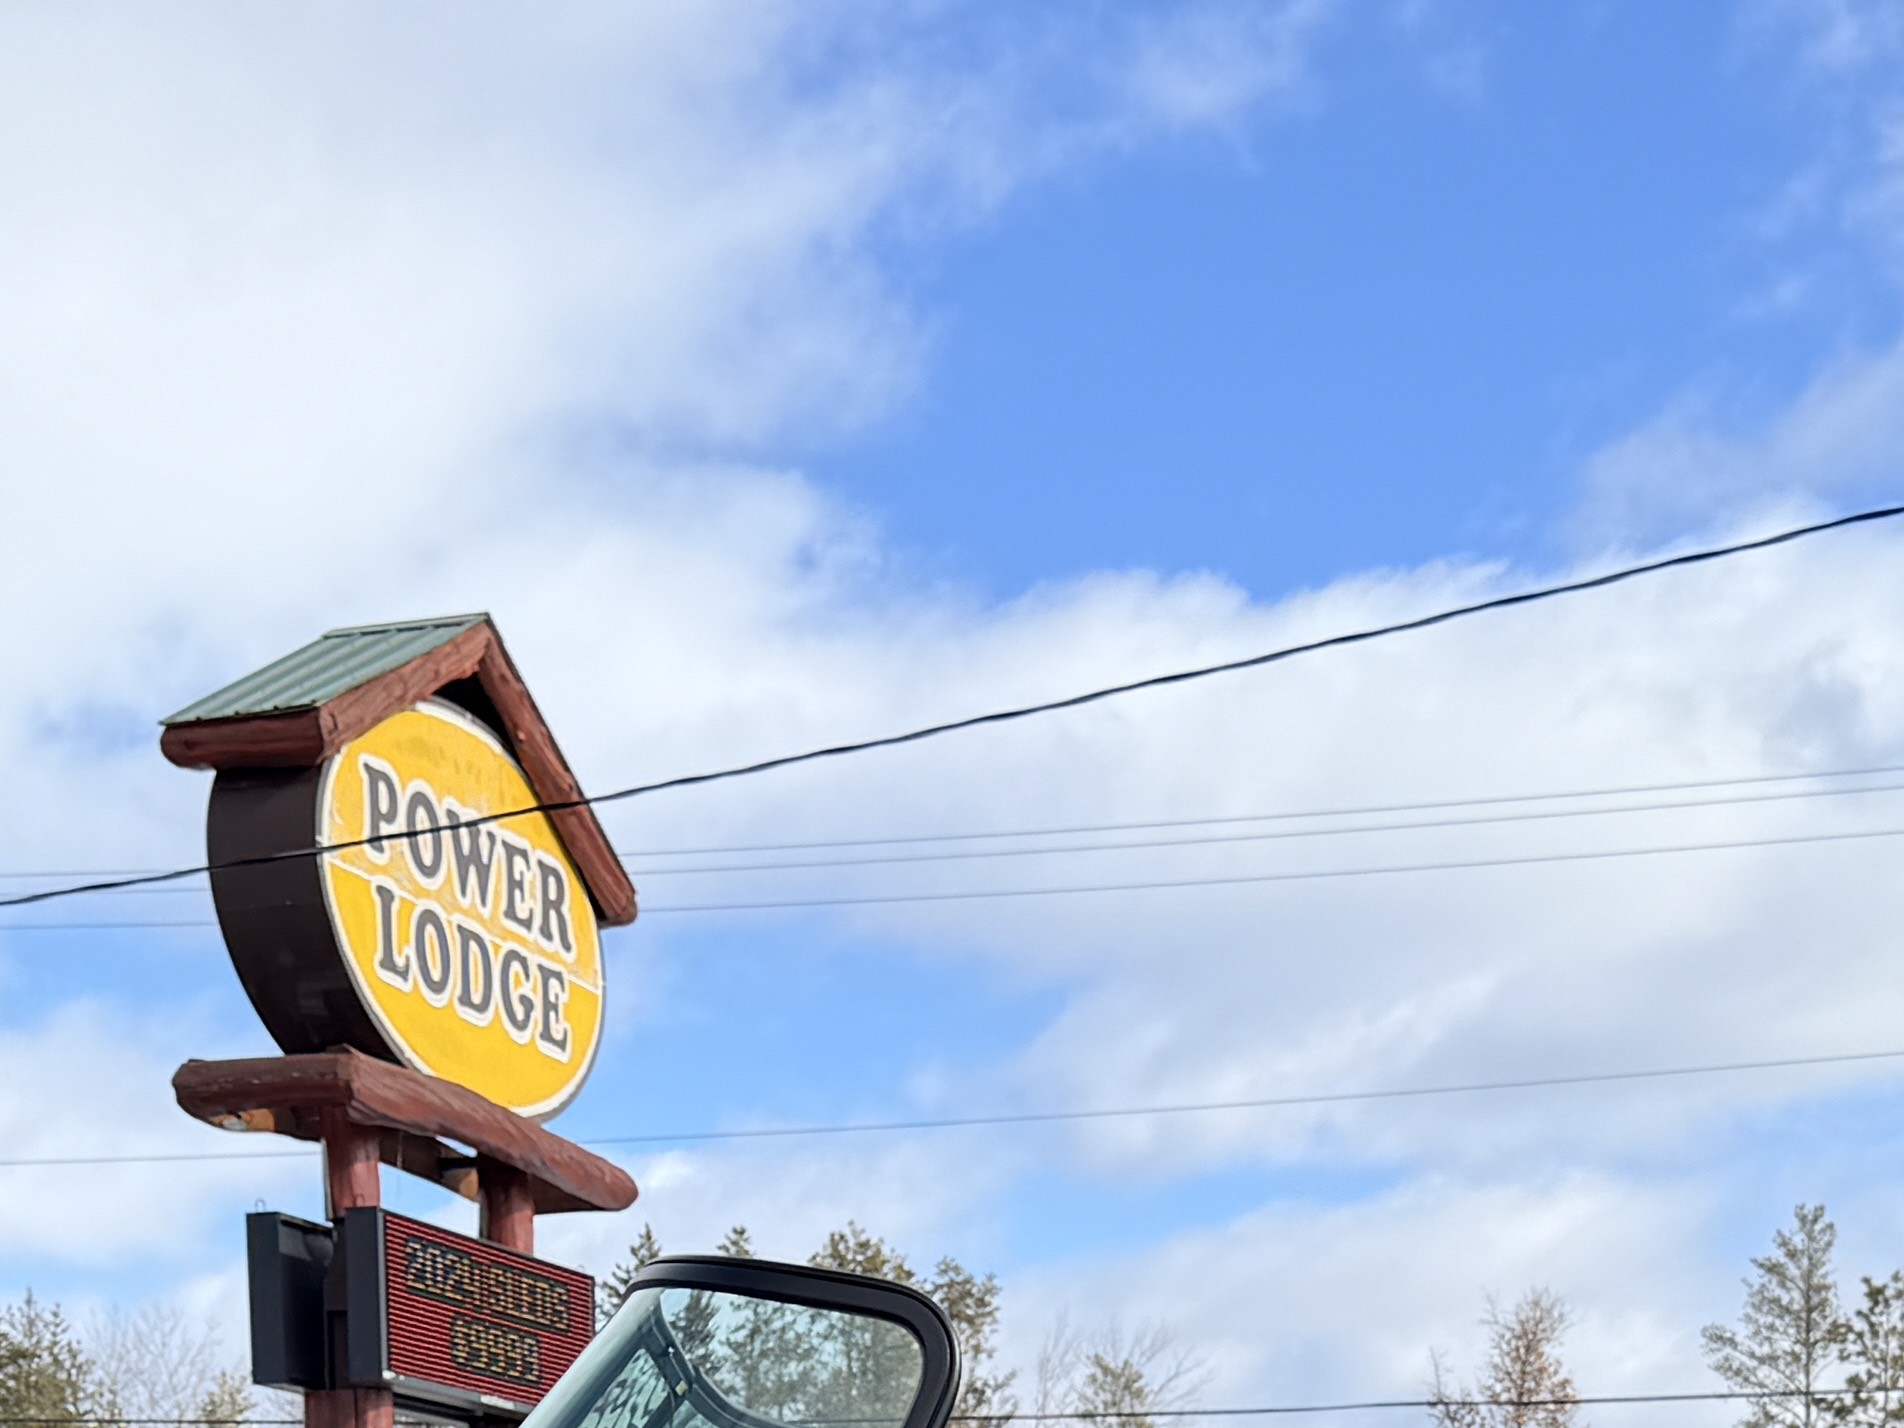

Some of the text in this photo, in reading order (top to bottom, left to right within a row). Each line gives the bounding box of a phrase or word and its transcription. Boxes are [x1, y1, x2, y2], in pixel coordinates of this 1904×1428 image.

[362, 760, 574, 955] POWER
[374, 883, 571, 1056] LODGE
[404, 1238, 569, 1331] 2024 SLEDS
